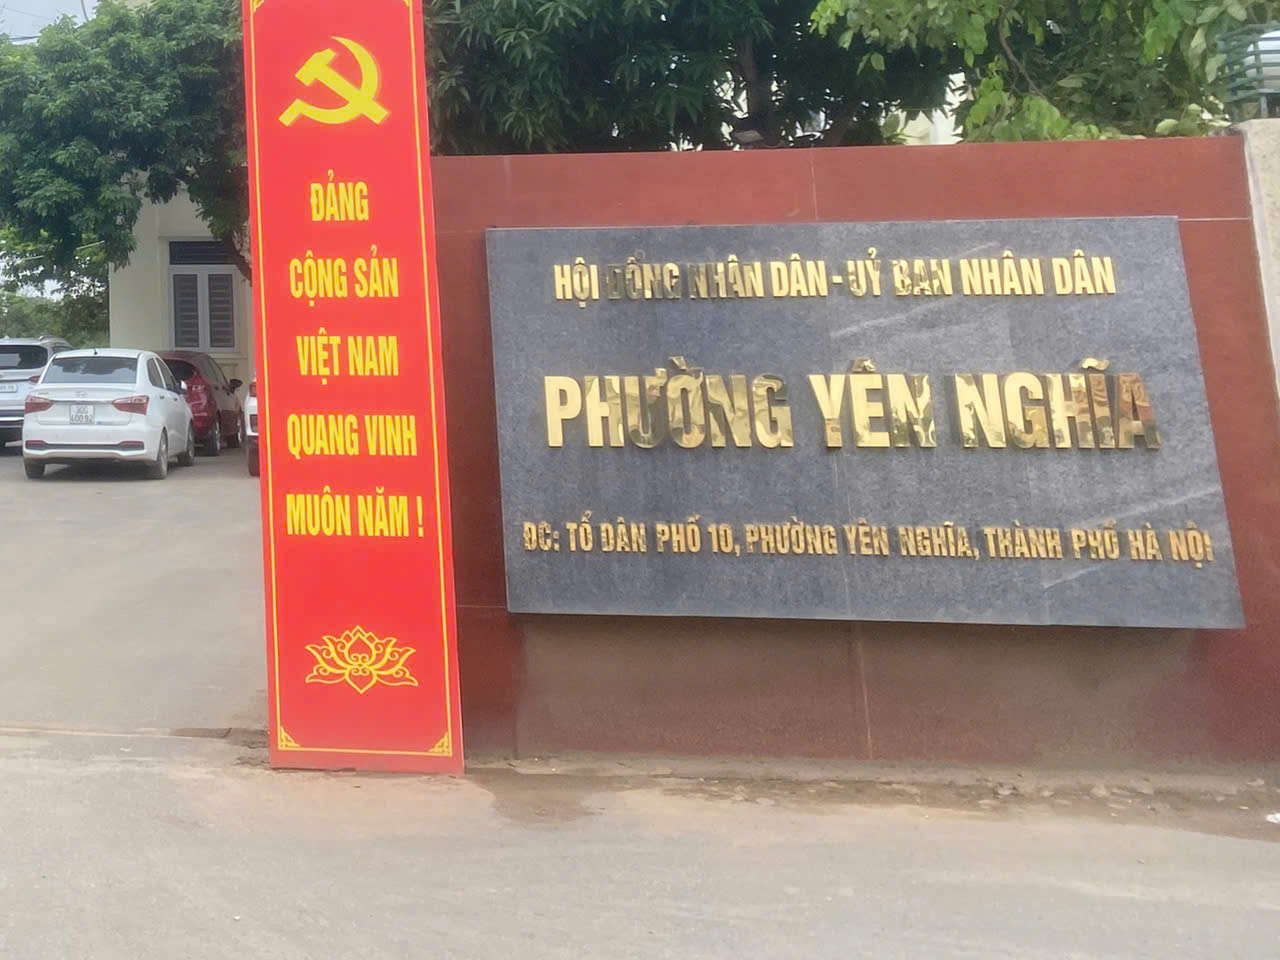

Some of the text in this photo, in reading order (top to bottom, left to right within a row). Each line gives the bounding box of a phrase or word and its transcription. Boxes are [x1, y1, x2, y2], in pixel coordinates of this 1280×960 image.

[310, 169, 369, 222] ĐẢNG
[289, 244, 399, 307] CỘNG SẢN
[554, 256, 599, 308] HỘI
[687, 254, 765, 299] NHÂN
[770, 253, 829, 298] DÂN
[847, 247, 881, 297] UỶ
[892, 258, 953, 296] BAN
[959, 250, 1044, 296] NHÂN
[1051, 249, 1116, 295] DÂN
[296, 327, 399, 385] VIỆT NAM
[544, 356, 1161, 450] PHƯỜNG YÊN NGHĨA
[287, 413, 417, 460] QUANG VINH
[286, 485, 351, 536] MUÔN
[523, 510, 1215, 569] ĐC: TỔ DÂN PHỐ 10, PHƯỜNG YÊN NGHĨA, THÀNH PHỐ HÀ NỘI
